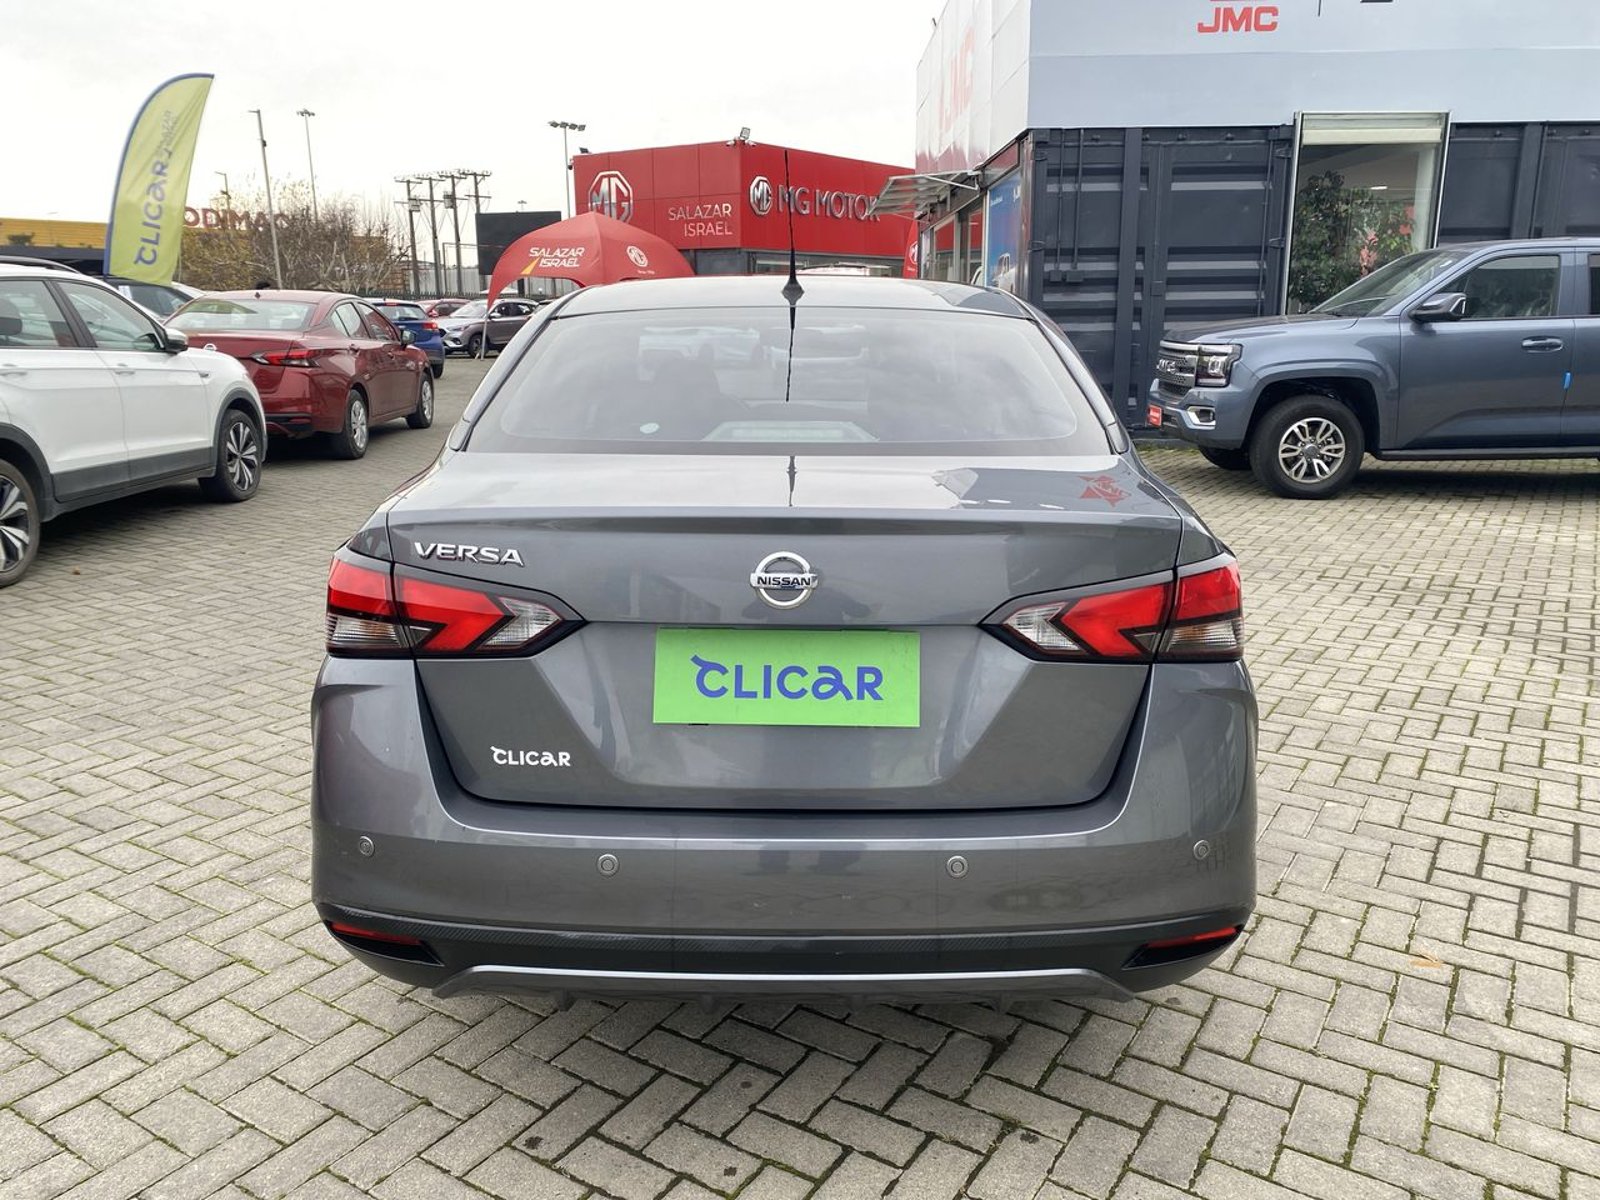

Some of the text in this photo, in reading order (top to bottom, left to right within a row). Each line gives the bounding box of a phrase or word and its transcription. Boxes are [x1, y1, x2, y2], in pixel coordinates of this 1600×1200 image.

[1197, 6, 1279, 33] JMC
[591, 176, 630, 222] MG
[777, 184, 880, 221] MG MOTOR
[183, 206, 290, 231] ODIMAC
[668, 203, 732, 221] SALAZAR
[684, 222, 733, 237] ISRAEL
[529, 247, 585, 257] SALAZAR
[539, 257, 580, 268] ISRAEL
[414, 542, 525, 567] VERSA
[757, 576, 811, 586] NISSAN
